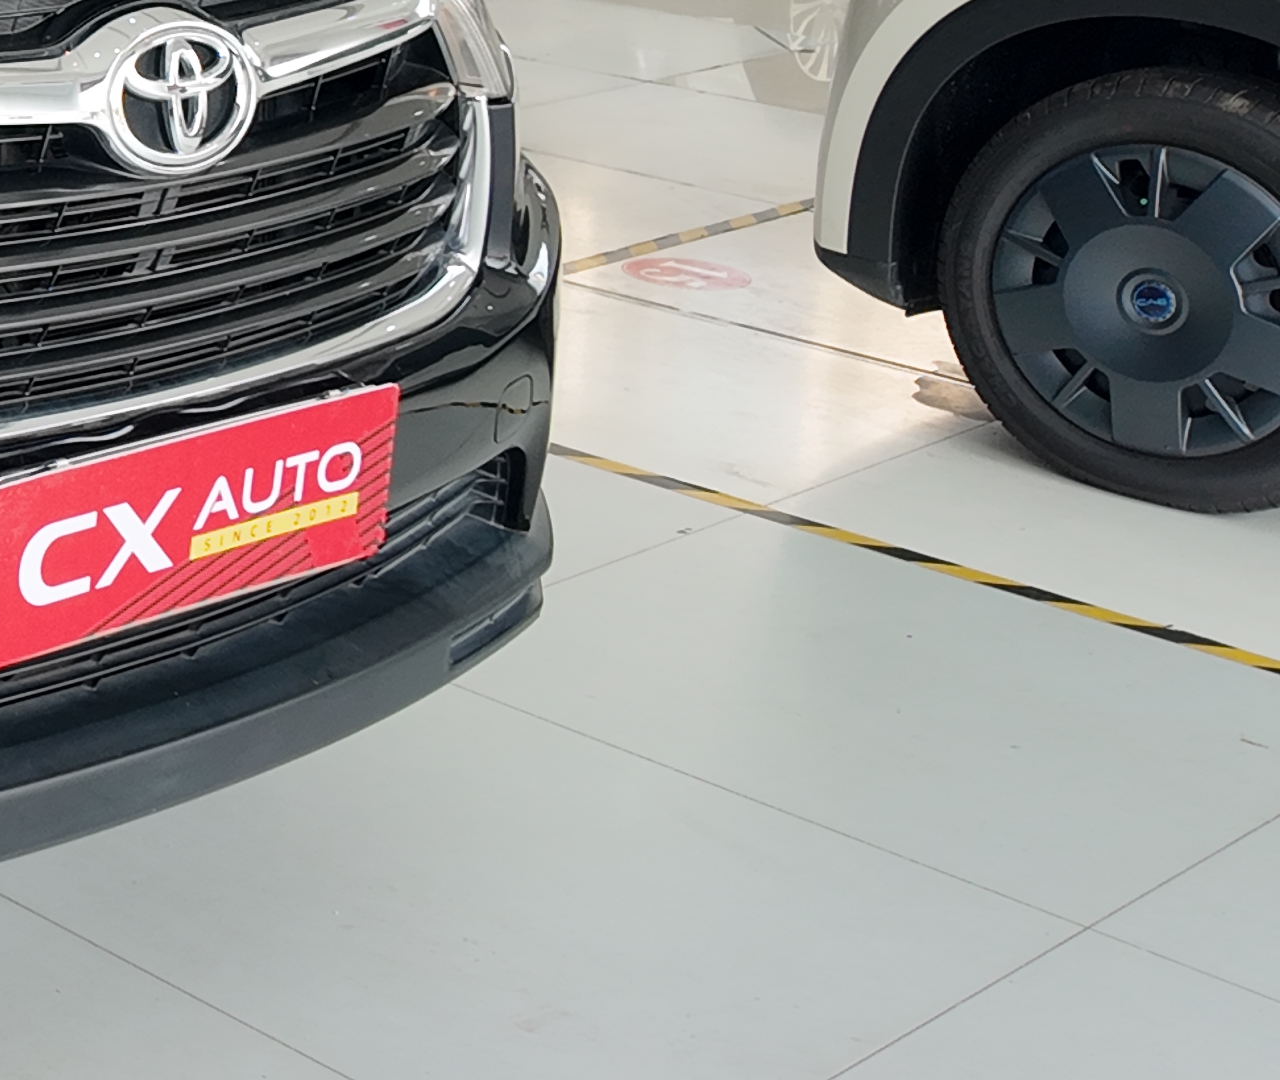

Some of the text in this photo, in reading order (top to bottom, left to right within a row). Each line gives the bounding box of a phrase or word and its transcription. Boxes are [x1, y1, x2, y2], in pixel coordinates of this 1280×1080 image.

[18, 441, 363, 607] CX AUTO
[202, 499, 350, 552] SINCE 2012
